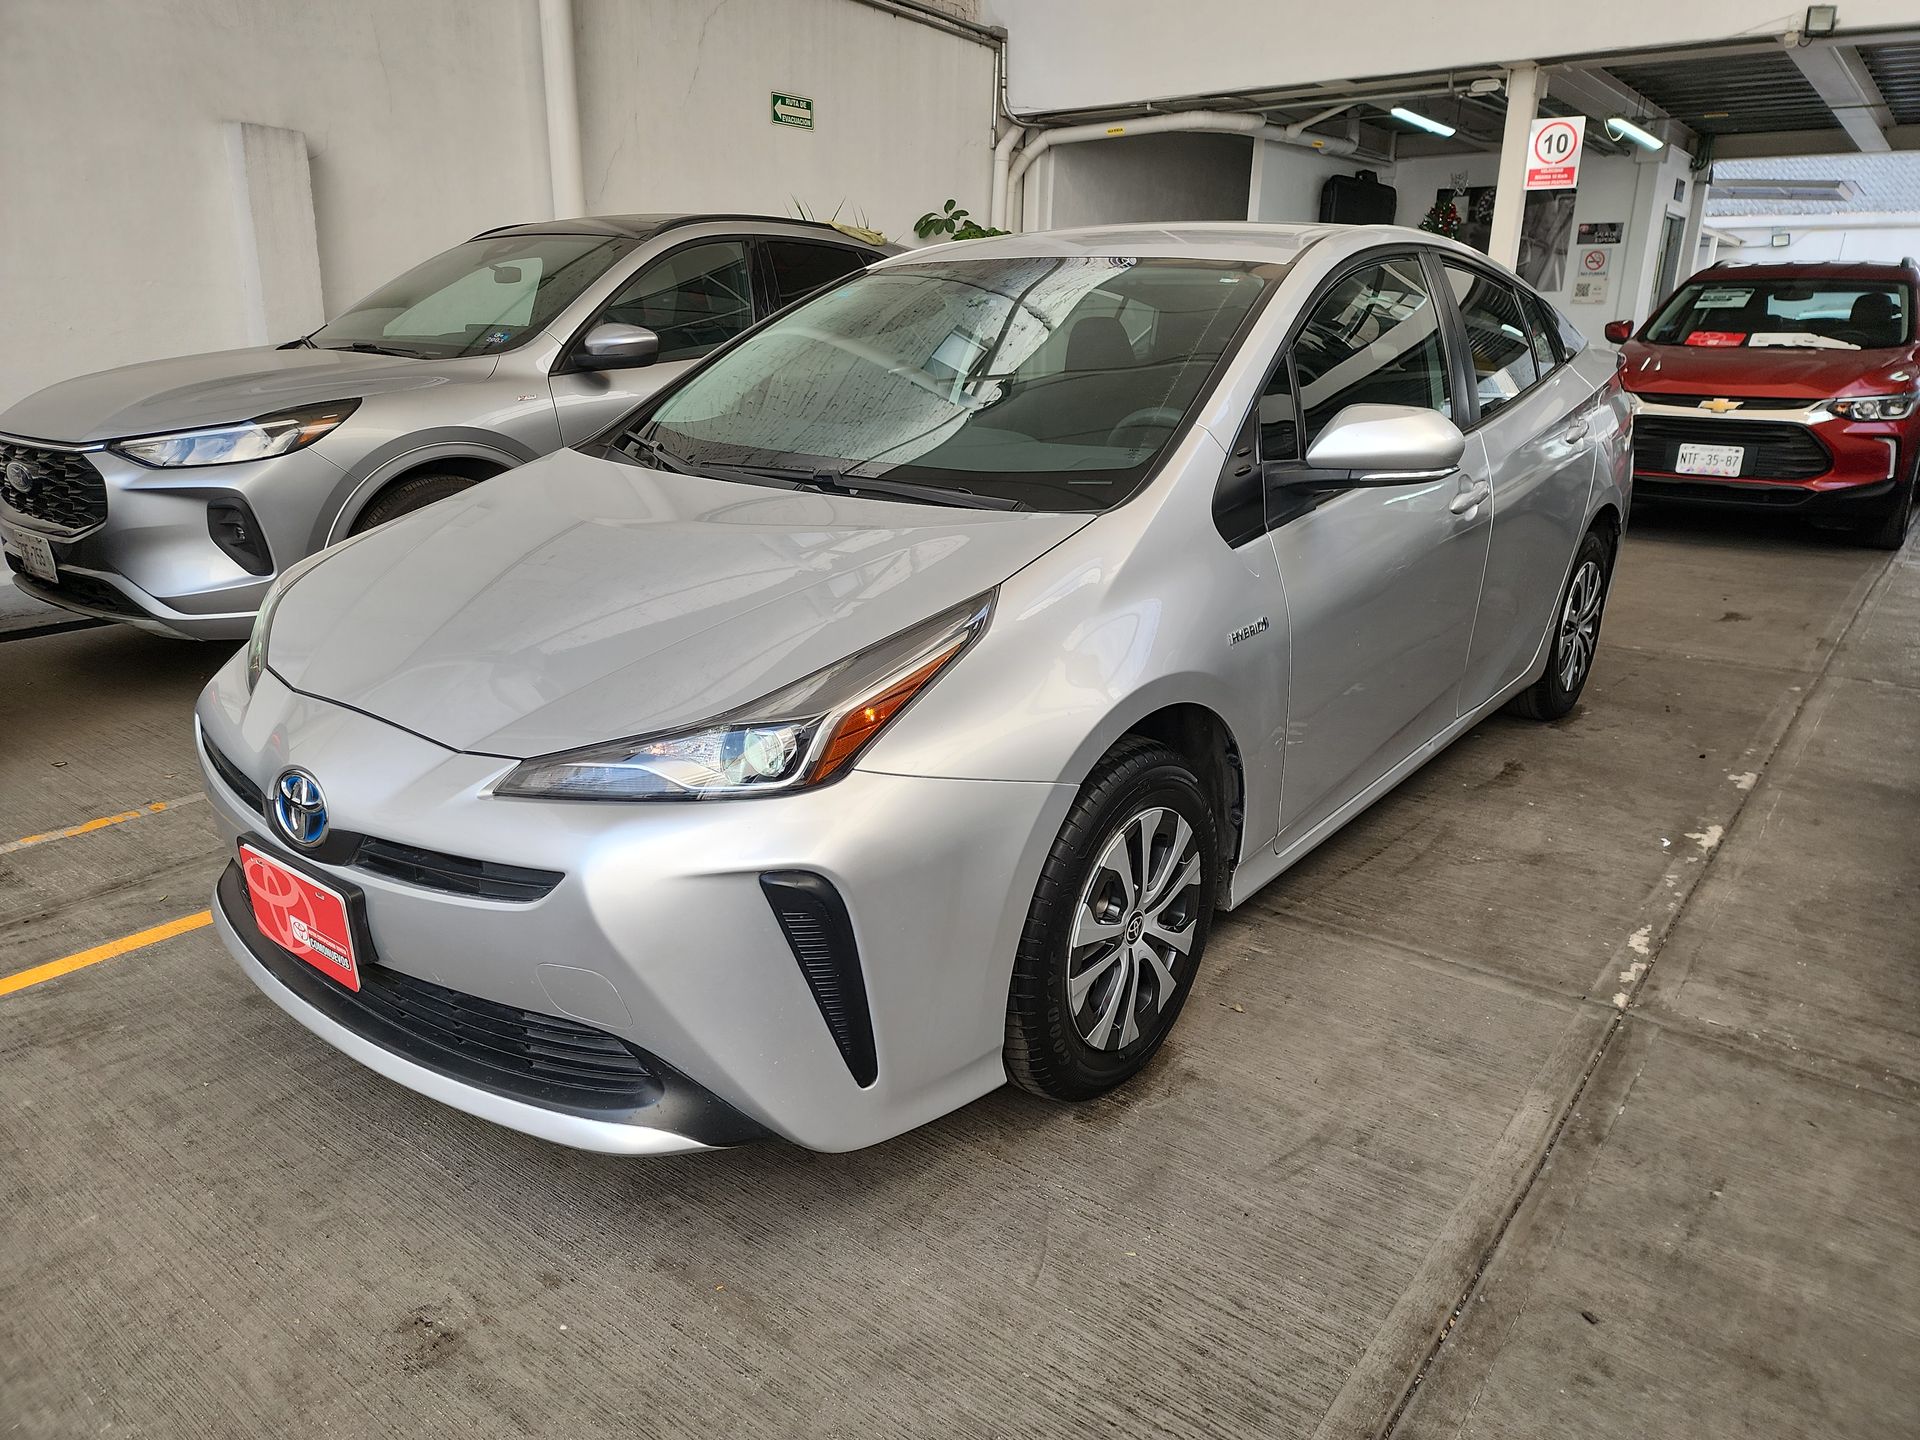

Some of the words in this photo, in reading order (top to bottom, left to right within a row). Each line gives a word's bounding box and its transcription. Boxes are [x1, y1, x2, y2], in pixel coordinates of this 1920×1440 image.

[785, 98, 799, 107] RUTA
[1544, 133, 1569, 154] 10
[1680, 452, 1739, 467] NTF-35-87
[1229, 616, 1270, 647] HYBRID
